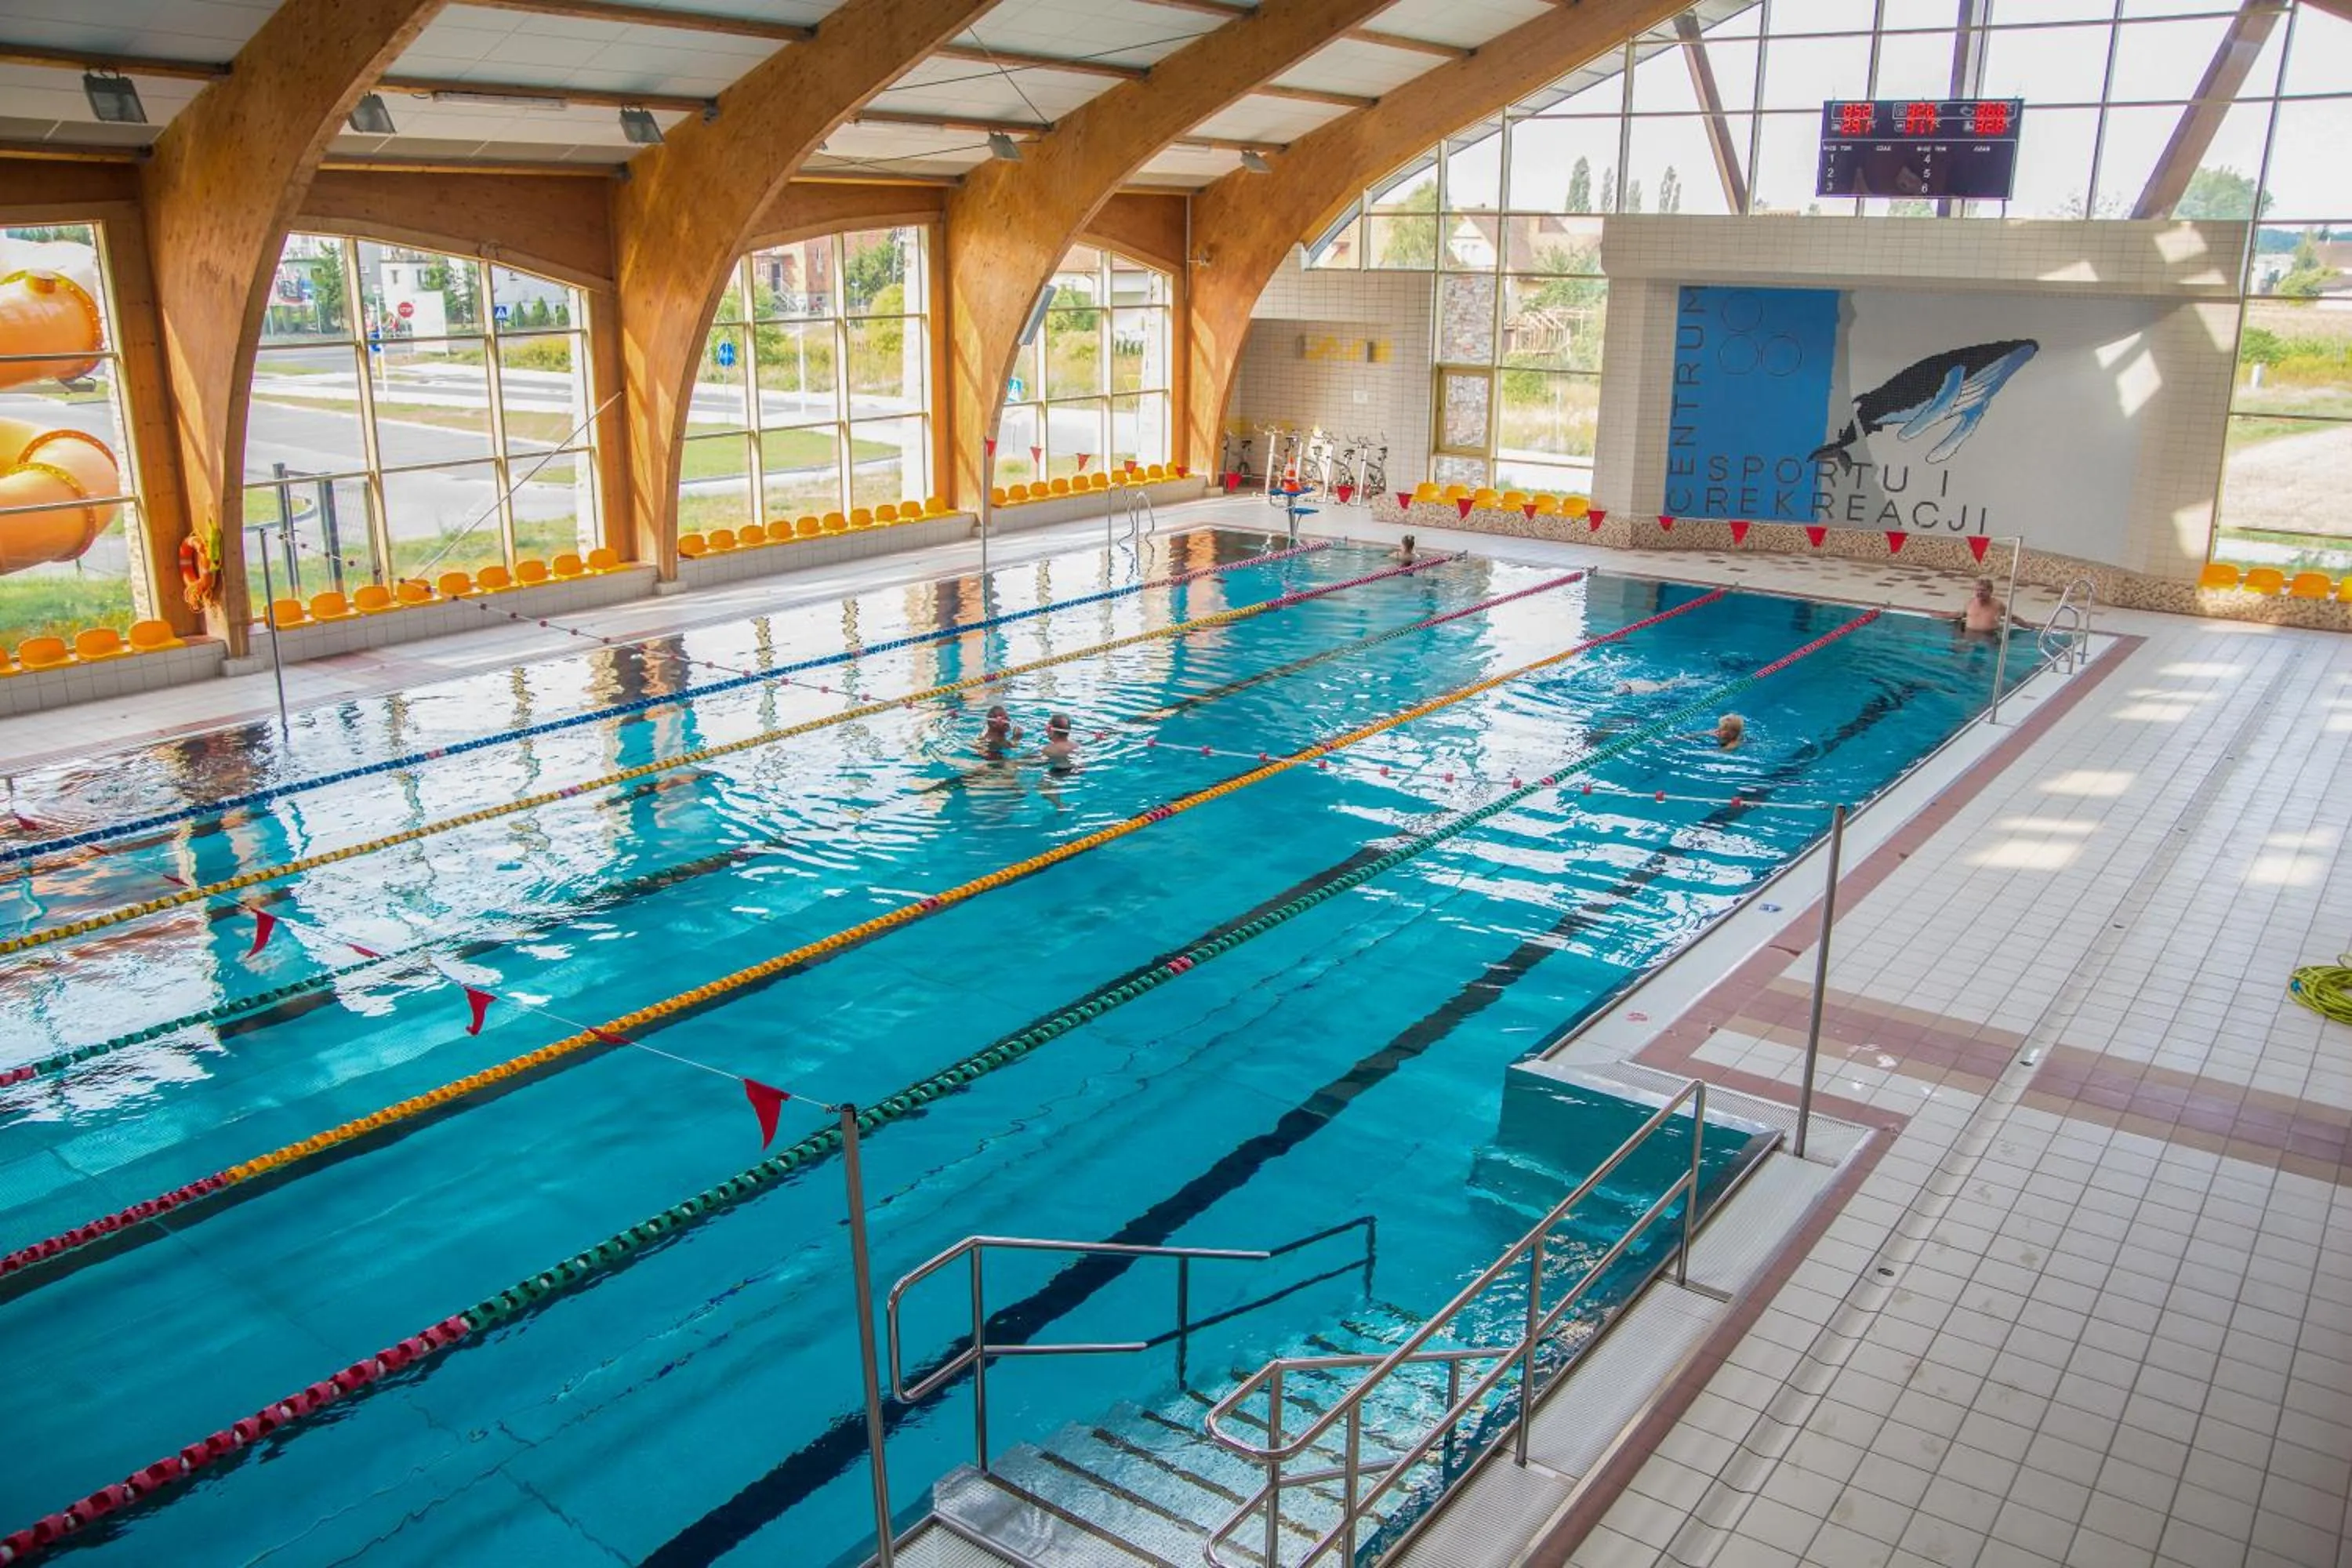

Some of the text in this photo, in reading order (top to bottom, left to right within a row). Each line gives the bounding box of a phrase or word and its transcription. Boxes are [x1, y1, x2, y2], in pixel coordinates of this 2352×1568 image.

[1923, 154, 1931, 164] 4
[1827, 167, 1835, 178] 2
[1923, 169, 1931, 179] 5
[1922, 183, 1929, 194] 6
[1668, 285, 1708, 514] CENTRUM
[1708, 455, 1908, 492] SPORTU
[1705, 488, 1987, 535] REKREACJI
